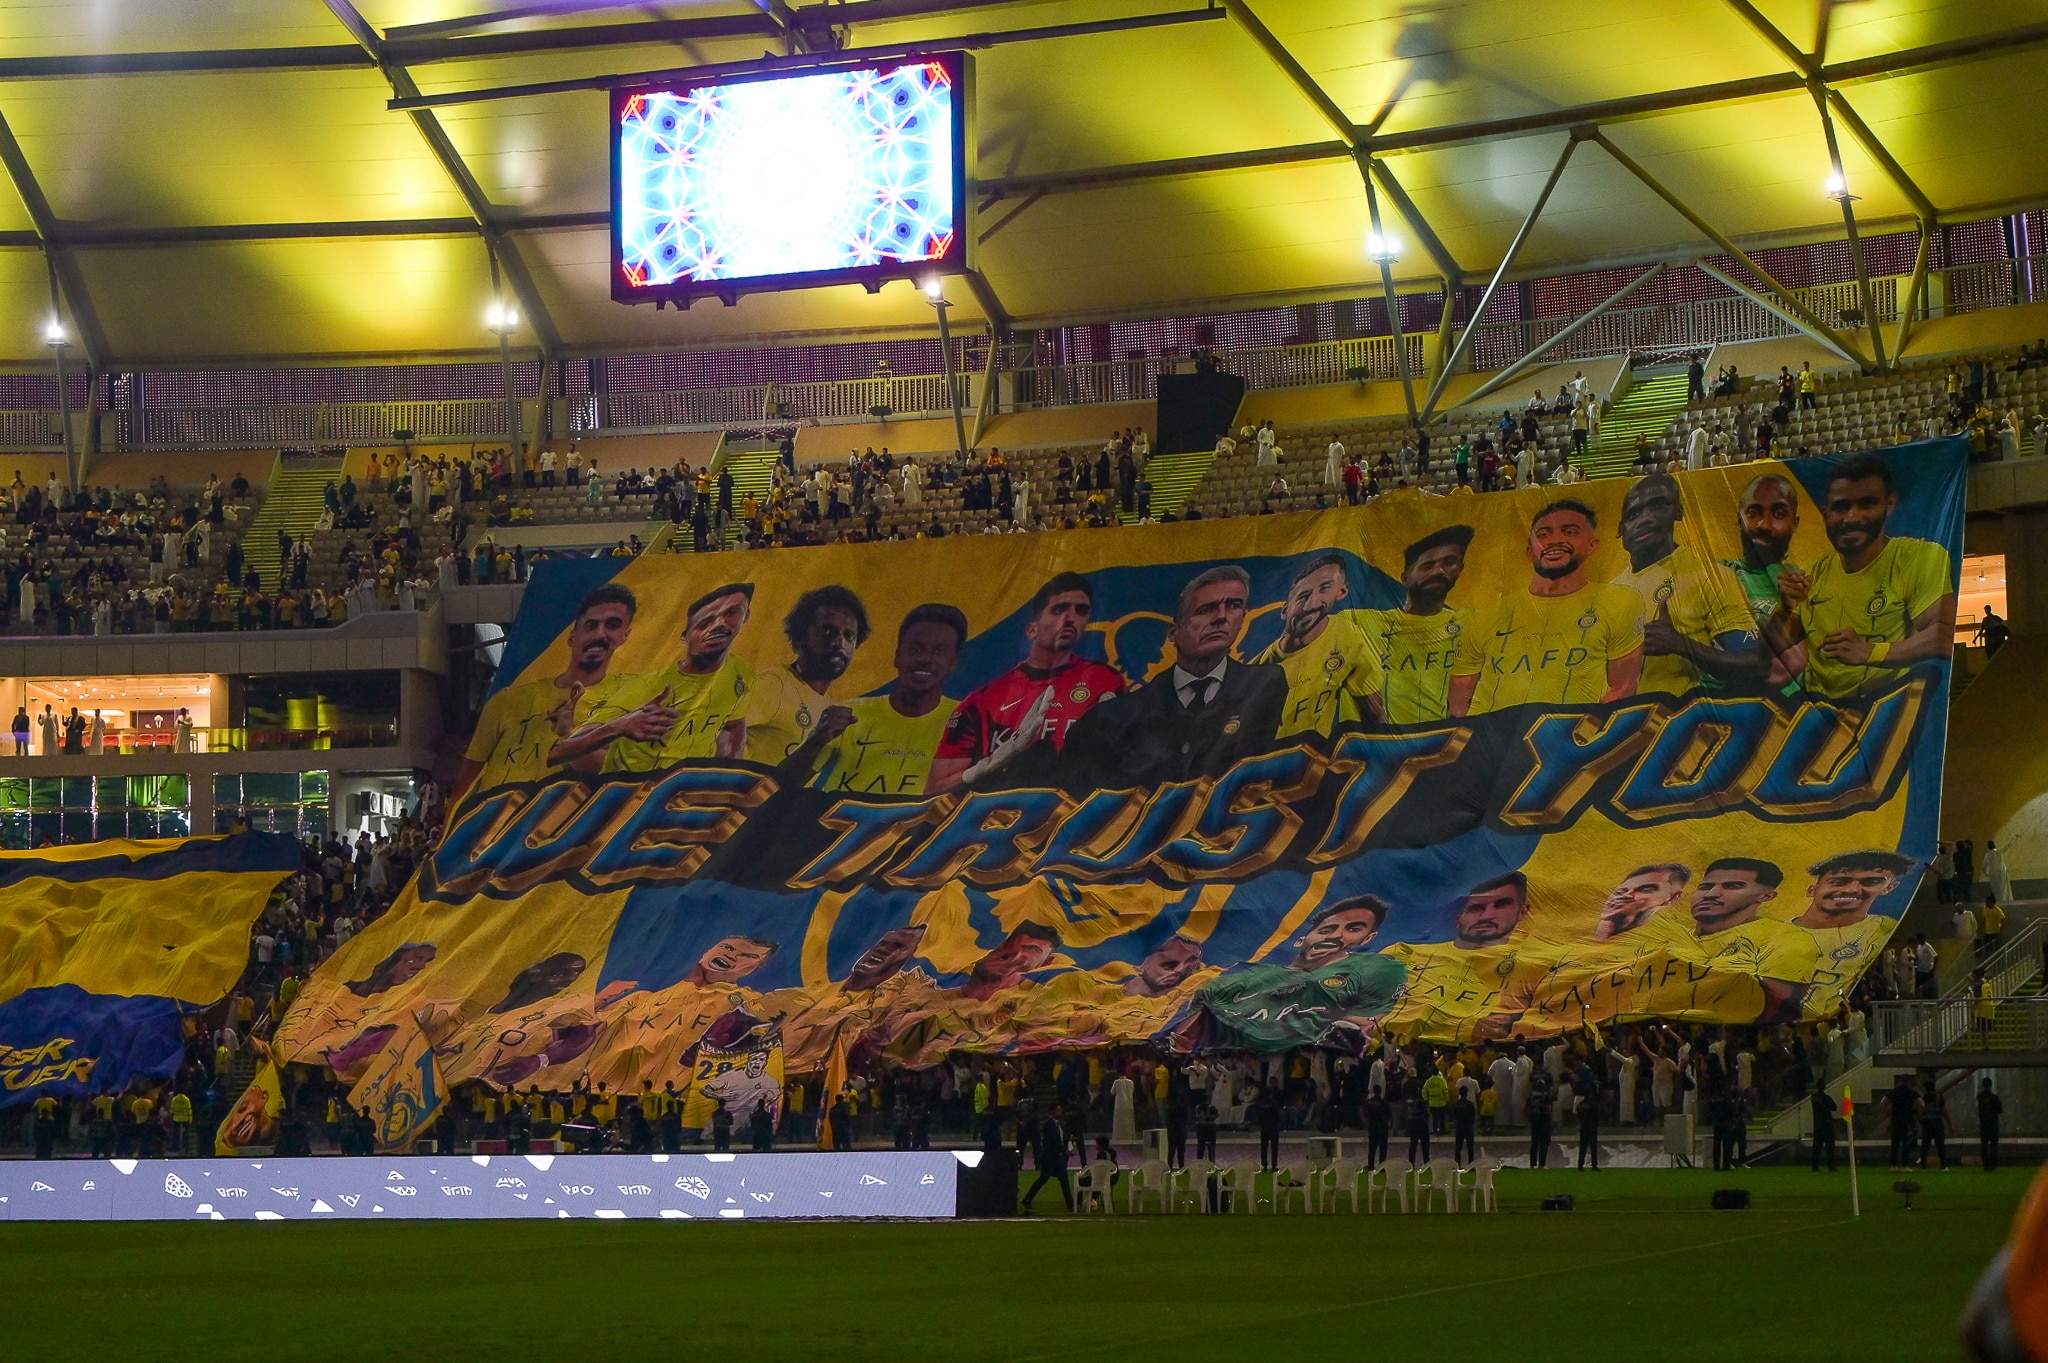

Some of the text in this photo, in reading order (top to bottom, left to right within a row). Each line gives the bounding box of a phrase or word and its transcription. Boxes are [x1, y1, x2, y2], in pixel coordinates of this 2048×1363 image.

[1491, 647, 1588, 675] KAFD
[432, 679, 1928, 894] WE TRUST YOU
[838, 771, 919, 793] KAF
[639, 1013, 711, 1030] KAF
